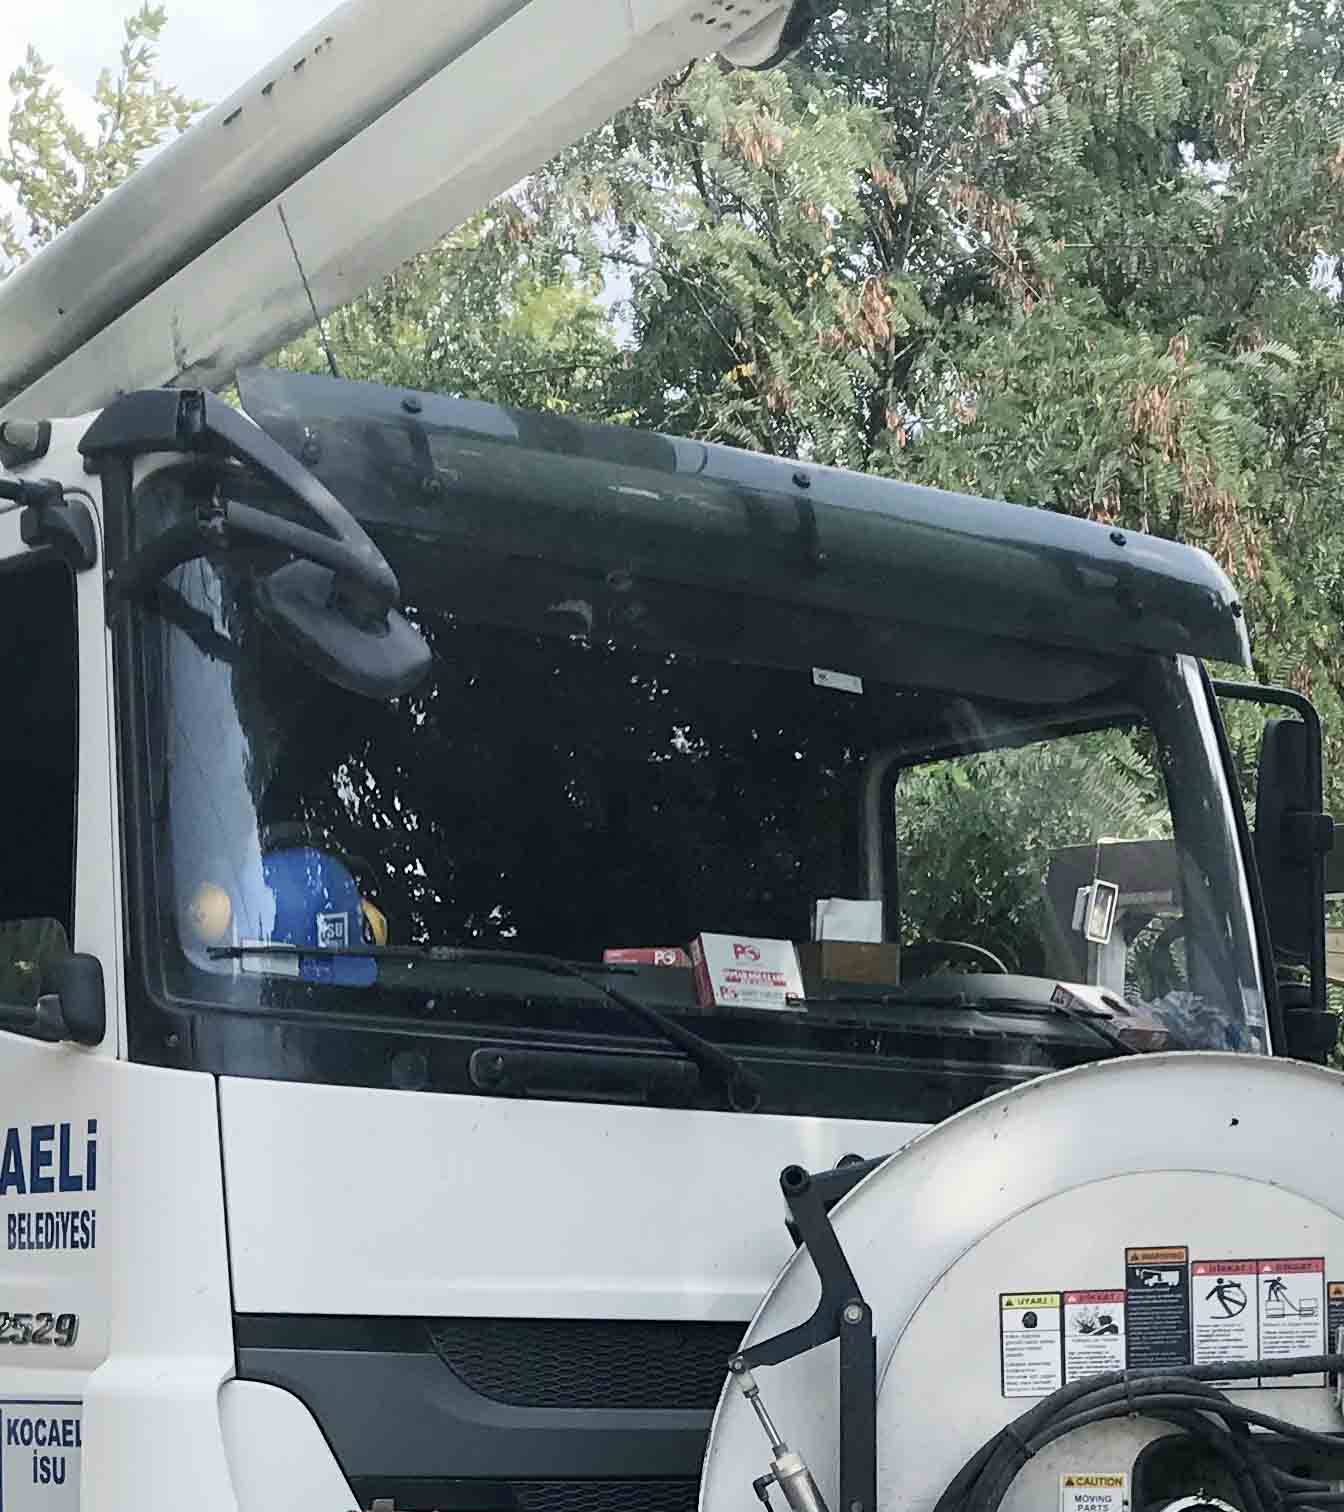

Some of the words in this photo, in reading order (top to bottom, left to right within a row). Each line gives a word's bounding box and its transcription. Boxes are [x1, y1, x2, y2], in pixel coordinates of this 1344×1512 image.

[7, 1209, 97, 1250] BELEDİYESİ
[6, 1418, 82, 1447] KOCAEL
[32, 1449, 66, 1484] İSU
[1076, 1475, 1123, 1487] CAUTION
[1074, 1494, 1112, 1503] MOVING
[1077, 1504, 1109, 1512] PARTS
